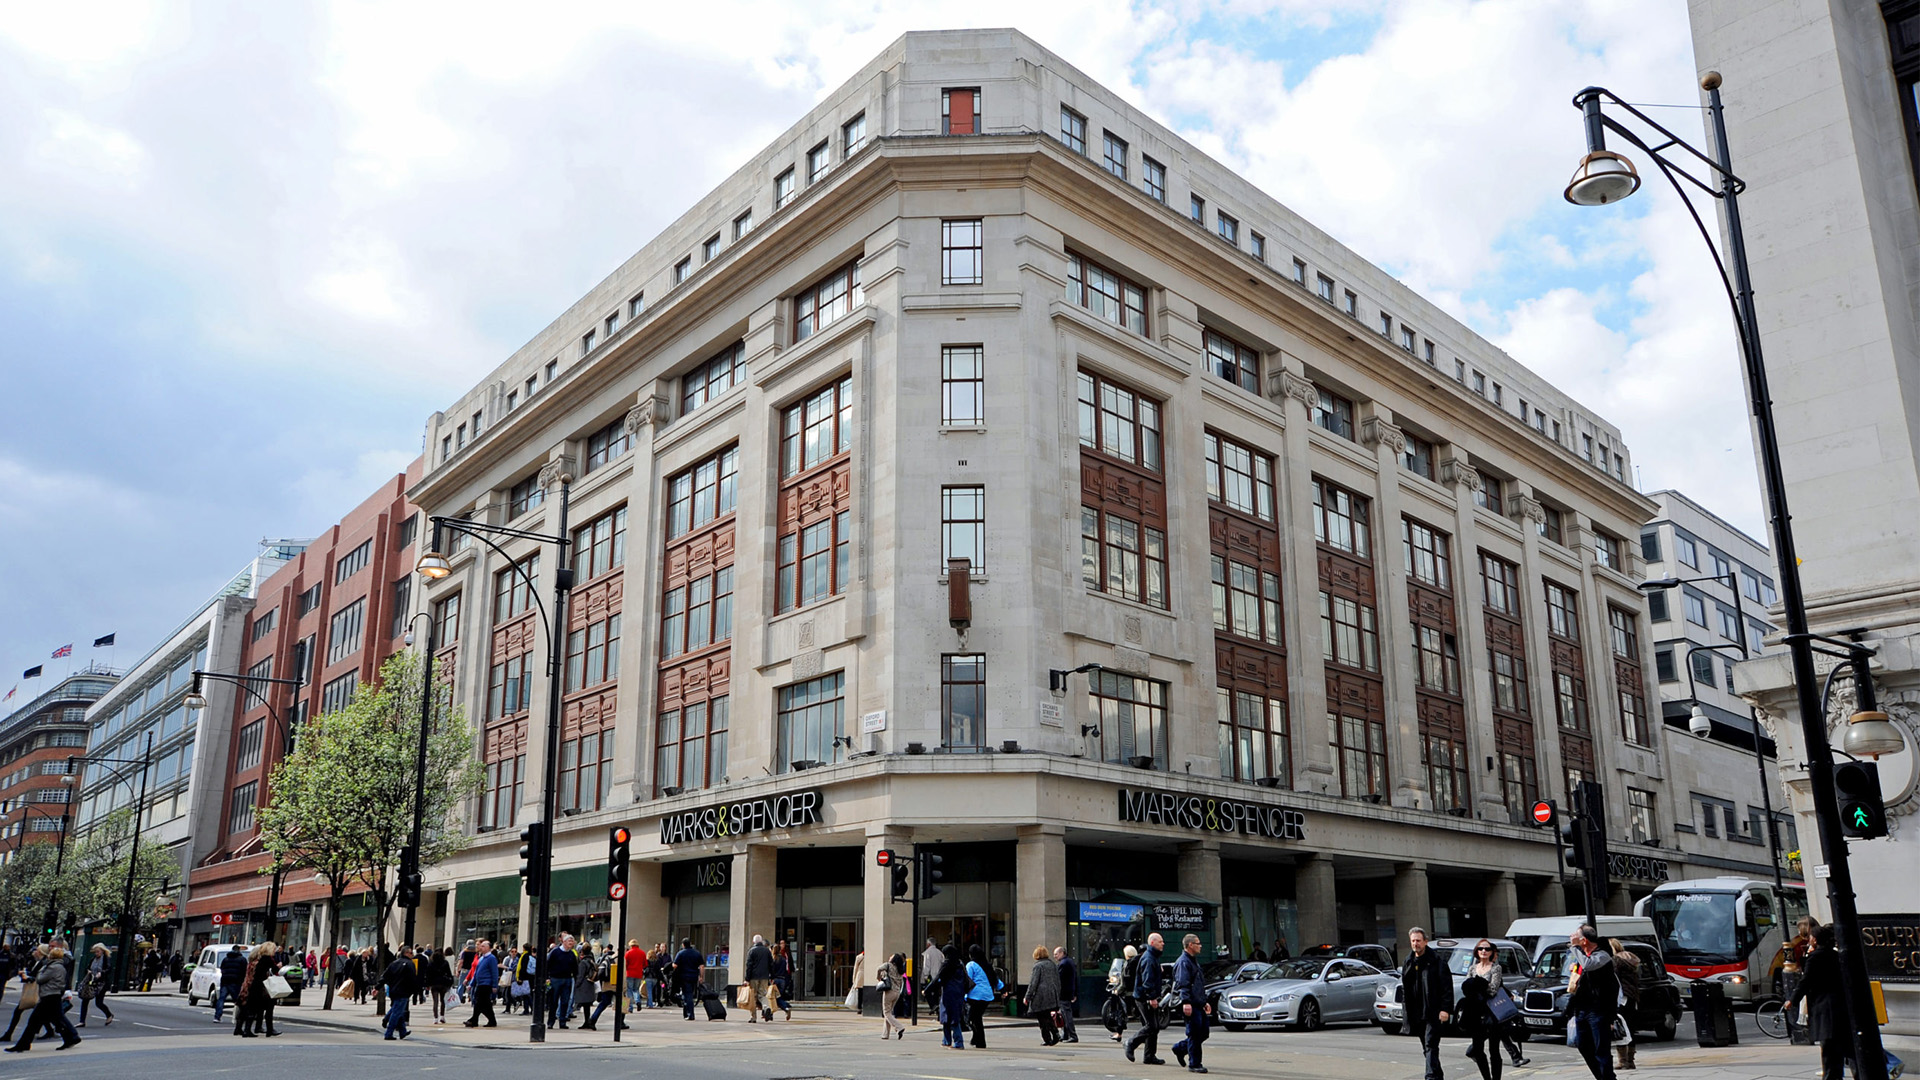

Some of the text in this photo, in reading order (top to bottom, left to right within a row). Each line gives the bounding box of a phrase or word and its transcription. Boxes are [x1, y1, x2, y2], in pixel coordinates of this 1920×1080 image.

[866, 713, 880, 721] OXFORD
[866, 719, 878, 727] STREET
[697, 861, 725, 887] M&S
[1676, 894, 1712, 904] Worthing
[1153, 905, 1168, 914] The
[1168, 905, 1188, 915] THREE
[1174, 914, 1203, 922] Restaurant
[1893, 950, 1907, 969] &
